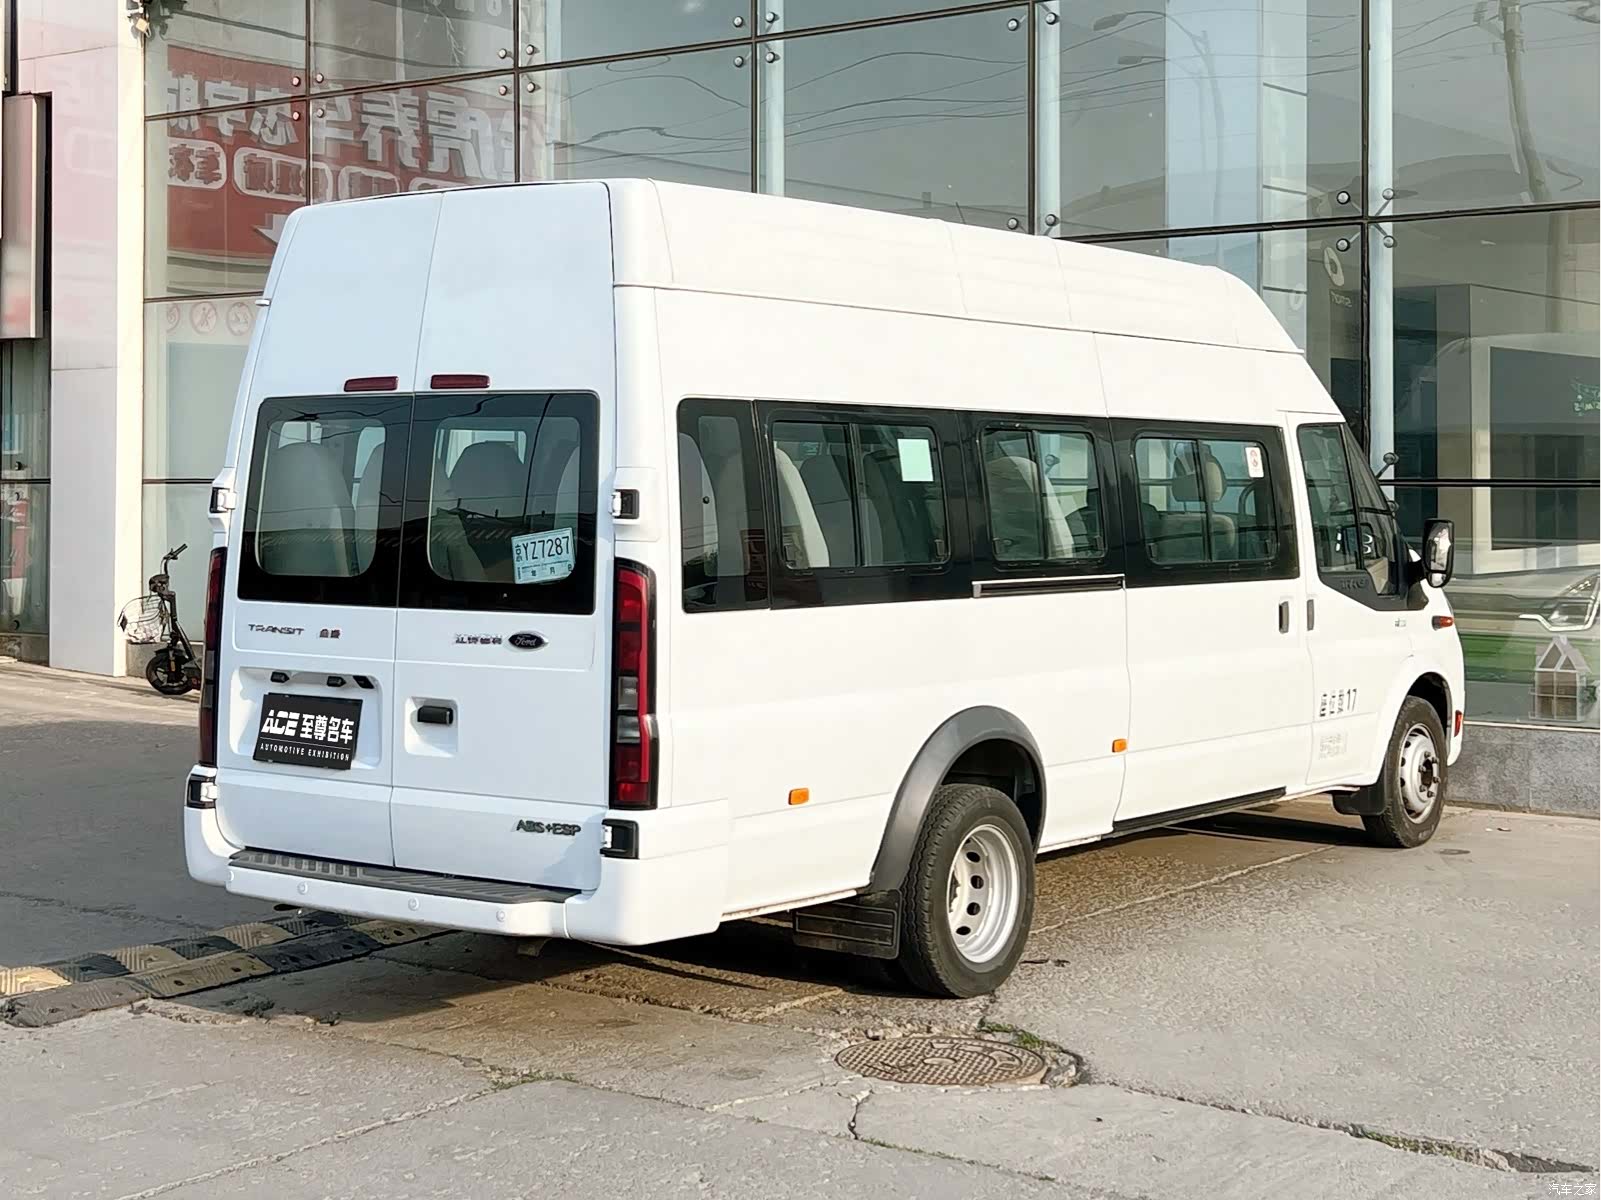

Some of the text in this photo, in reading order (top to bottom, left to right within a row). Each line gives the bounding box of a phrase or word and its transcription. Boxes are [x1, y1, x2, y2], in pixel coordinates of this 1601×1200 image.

[247, 623, 305, 636] TRANSIT
[260, 709, 355, 745] ACE 至尊名车
[259, 742, 350, 761] AUTOMOTIVE EXHIBITION
